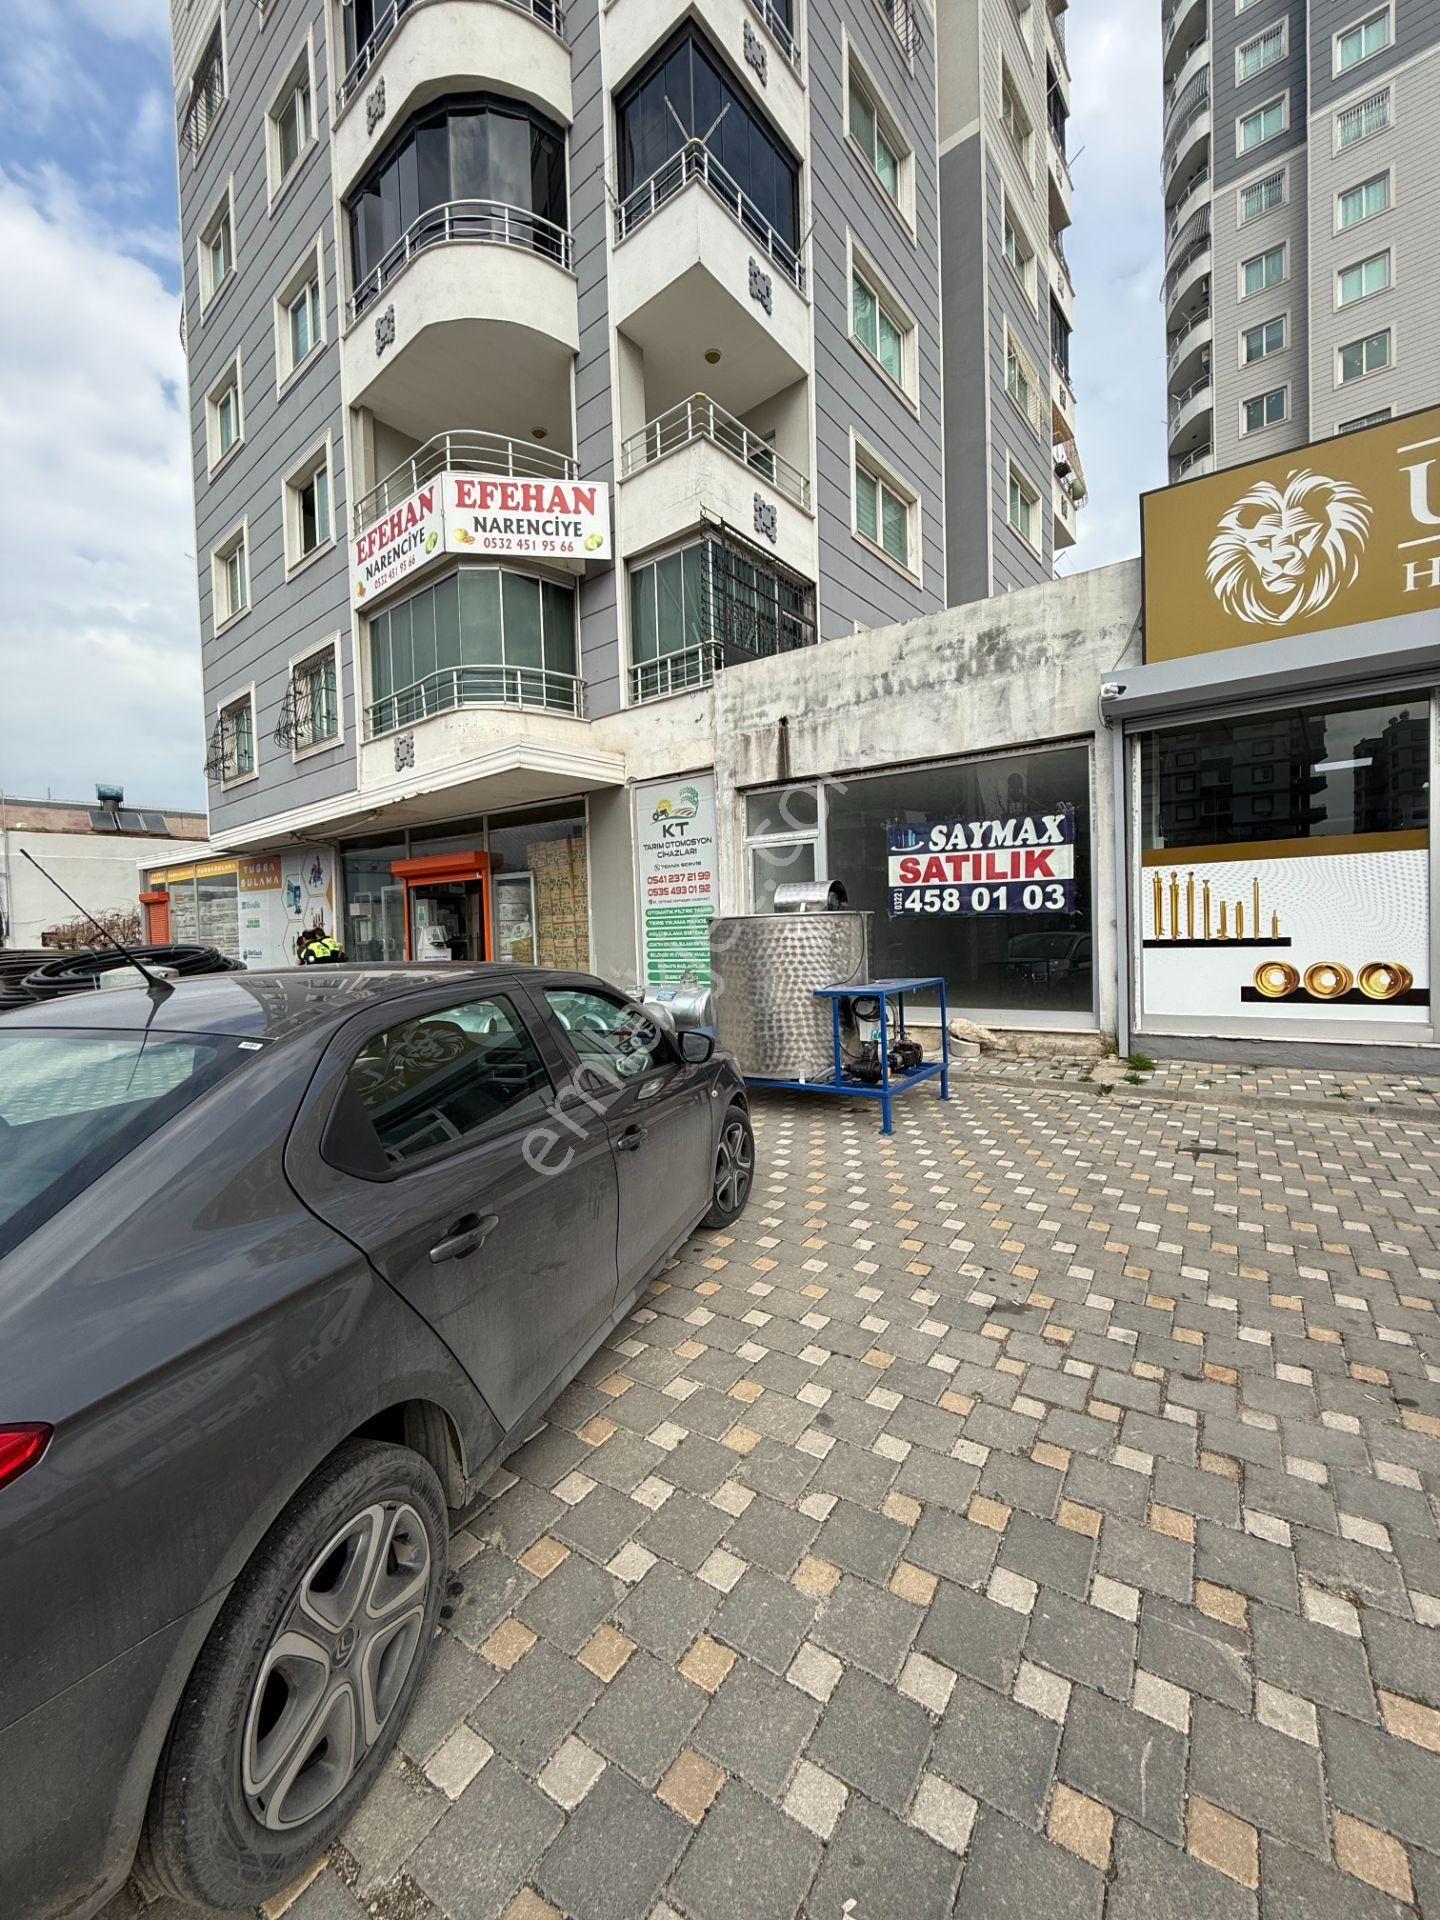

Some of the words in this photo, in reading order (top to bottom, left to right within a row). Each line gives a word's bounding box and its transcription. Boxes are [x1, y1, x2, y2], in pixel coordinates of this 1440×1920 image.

[455, 479, 598, 516] EFEHAN
[356, 485, 434, 566] EFEHAN
[473, 516, 583, 537] NARENCİYE
[365, 527, 426, 581] NARENCİYE
[484, 537, 512, 549] 0532
[516, 539, 537, 551] 451
[541, 540, 556, 552] 95
[560, 540, 574, 552] 66
[374, 573, 388, 590] 0532
[388, 567, 399, 582] 451
[400, 561, 408, 575] 95
[408, 555, 416, 570] 66
[662, 821, 689, 838] KT
[929, 814, 1065, 851] SAYMAX
[643, 843, 664, 851] TARIM
[647, 875, 667, 884] 0541
[668, 873, 685, 883] 237
[687, 872, 696, 881] 21
[697, 871, 711, 880] 99
[899, 848, 1055, 884] SATILIK
[670, 886, 687, 895] 493
[688, 885, 697, 893] 01
[699, 884, 711, 892] 92
[905, 888, 960, 913] 458
[971, 886, 1007, 911] 01
[1022, 884, 1065, 910] 03
[253, 1638, 265, 1651] R
[261, 1611, 276, 1631] 16
